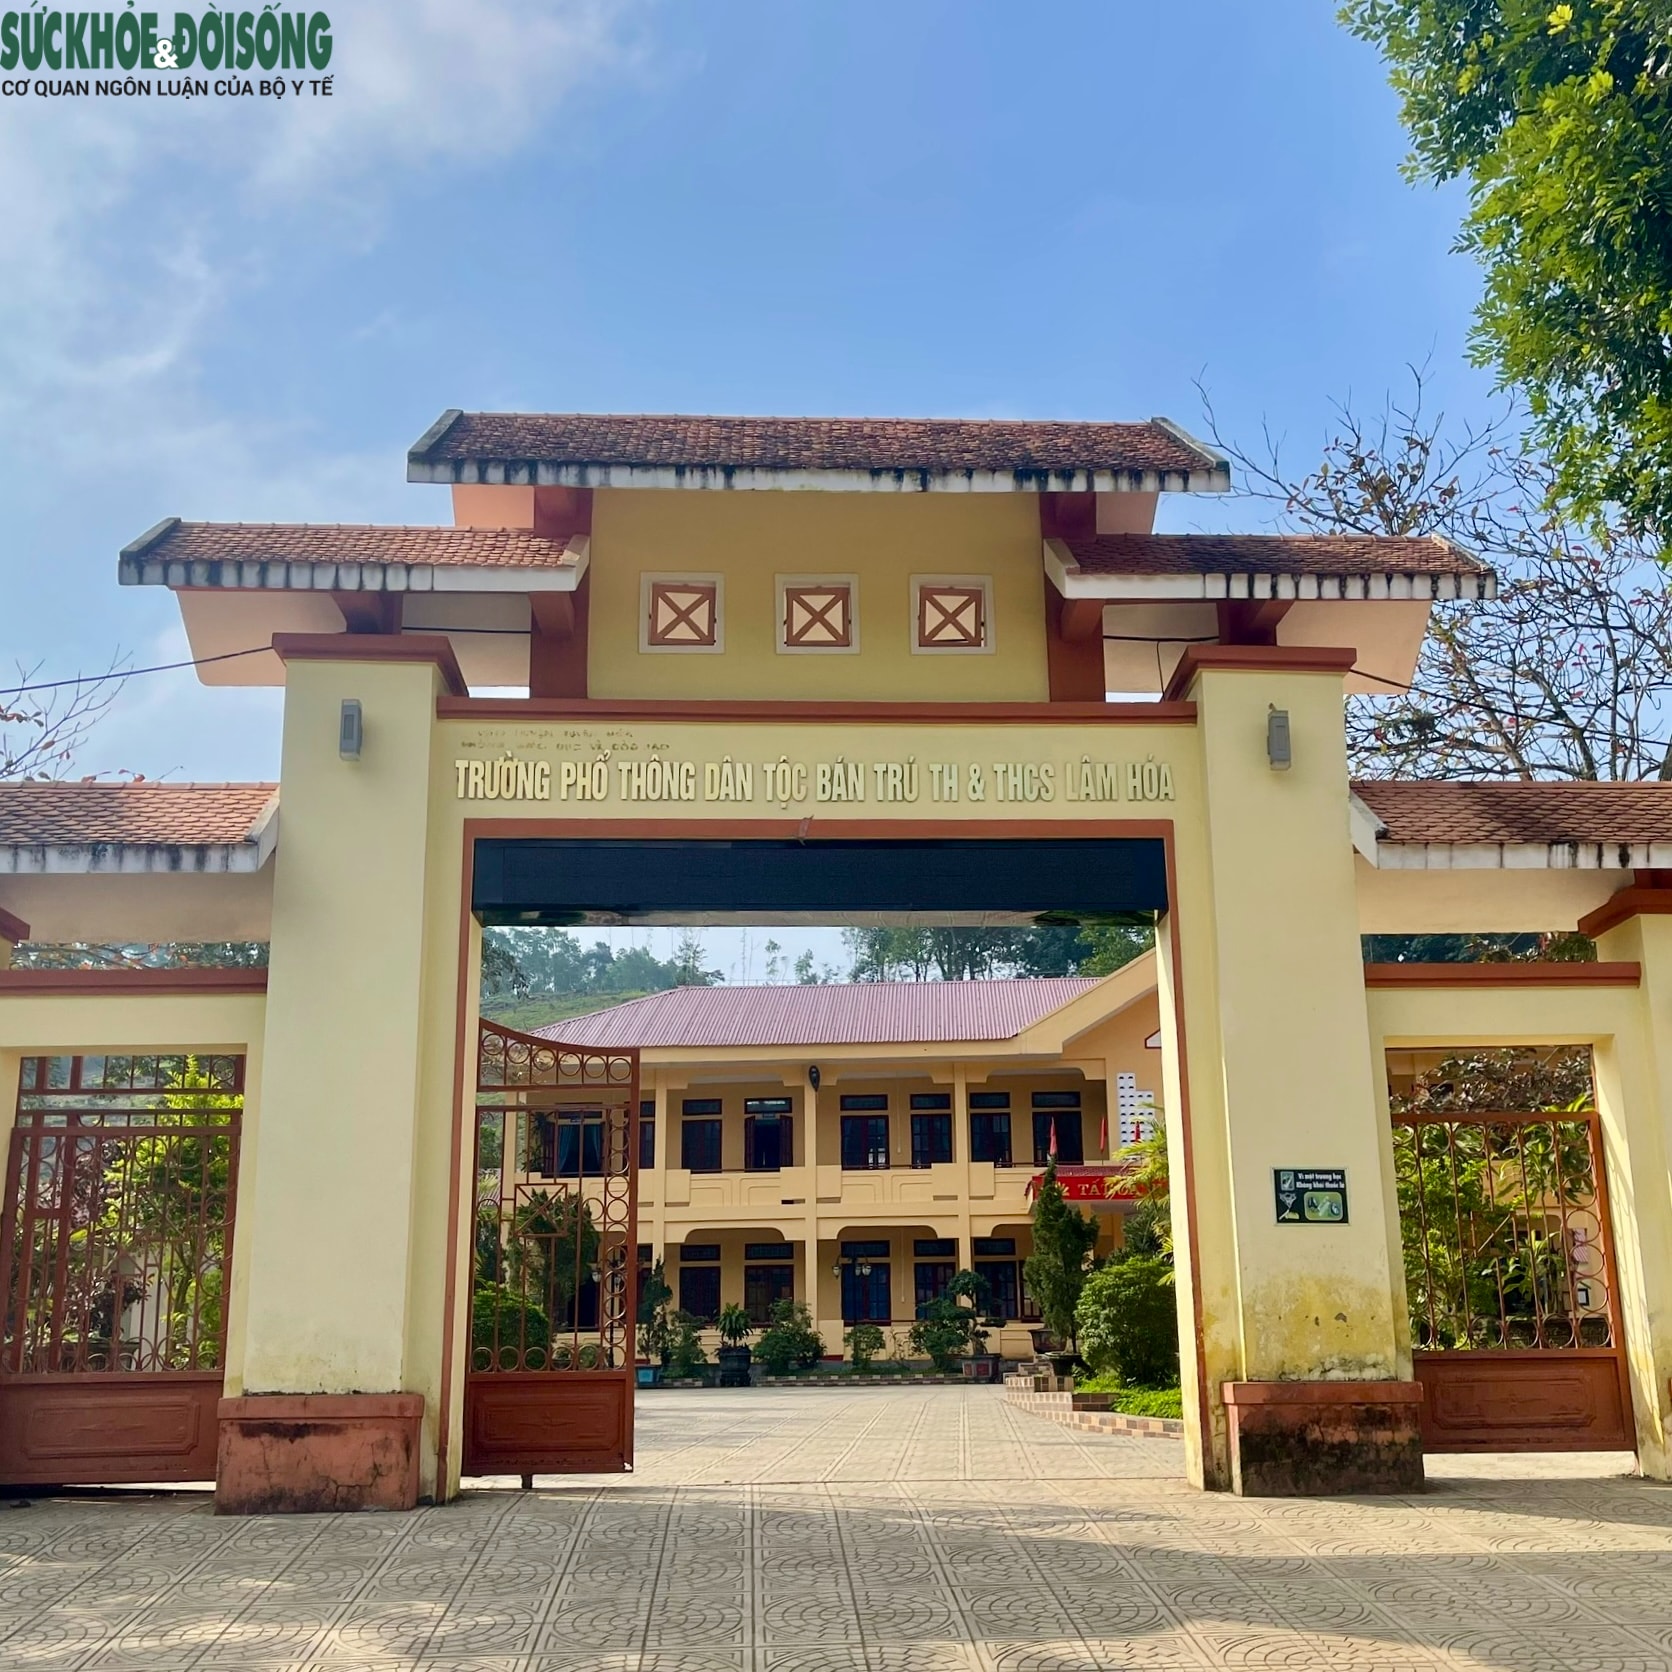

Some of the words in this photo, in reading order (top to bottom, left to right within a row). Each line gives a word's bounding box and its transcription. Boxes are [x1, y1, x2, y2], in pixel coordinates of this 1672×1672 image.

[455, 750, 550, 799] TRƯỜNG
[560, 750, 611, 800] PHỔ
[618, 753, 695, 801] THÔNG
[704, 755, 753, 802] DÂN
[763, 755, 807, 809] TỘC
[816, 756, 865, 802] BÁN
[873, 756, 919, 802] TRÚ
[928, 763, 959, 802] TH
[968, 763, 986, 802] &
[993, 763, 1055, 802] THCS
[1065, 756, 1118, 802] LÂM
[1126, 754, 1175, 802] HÓA
